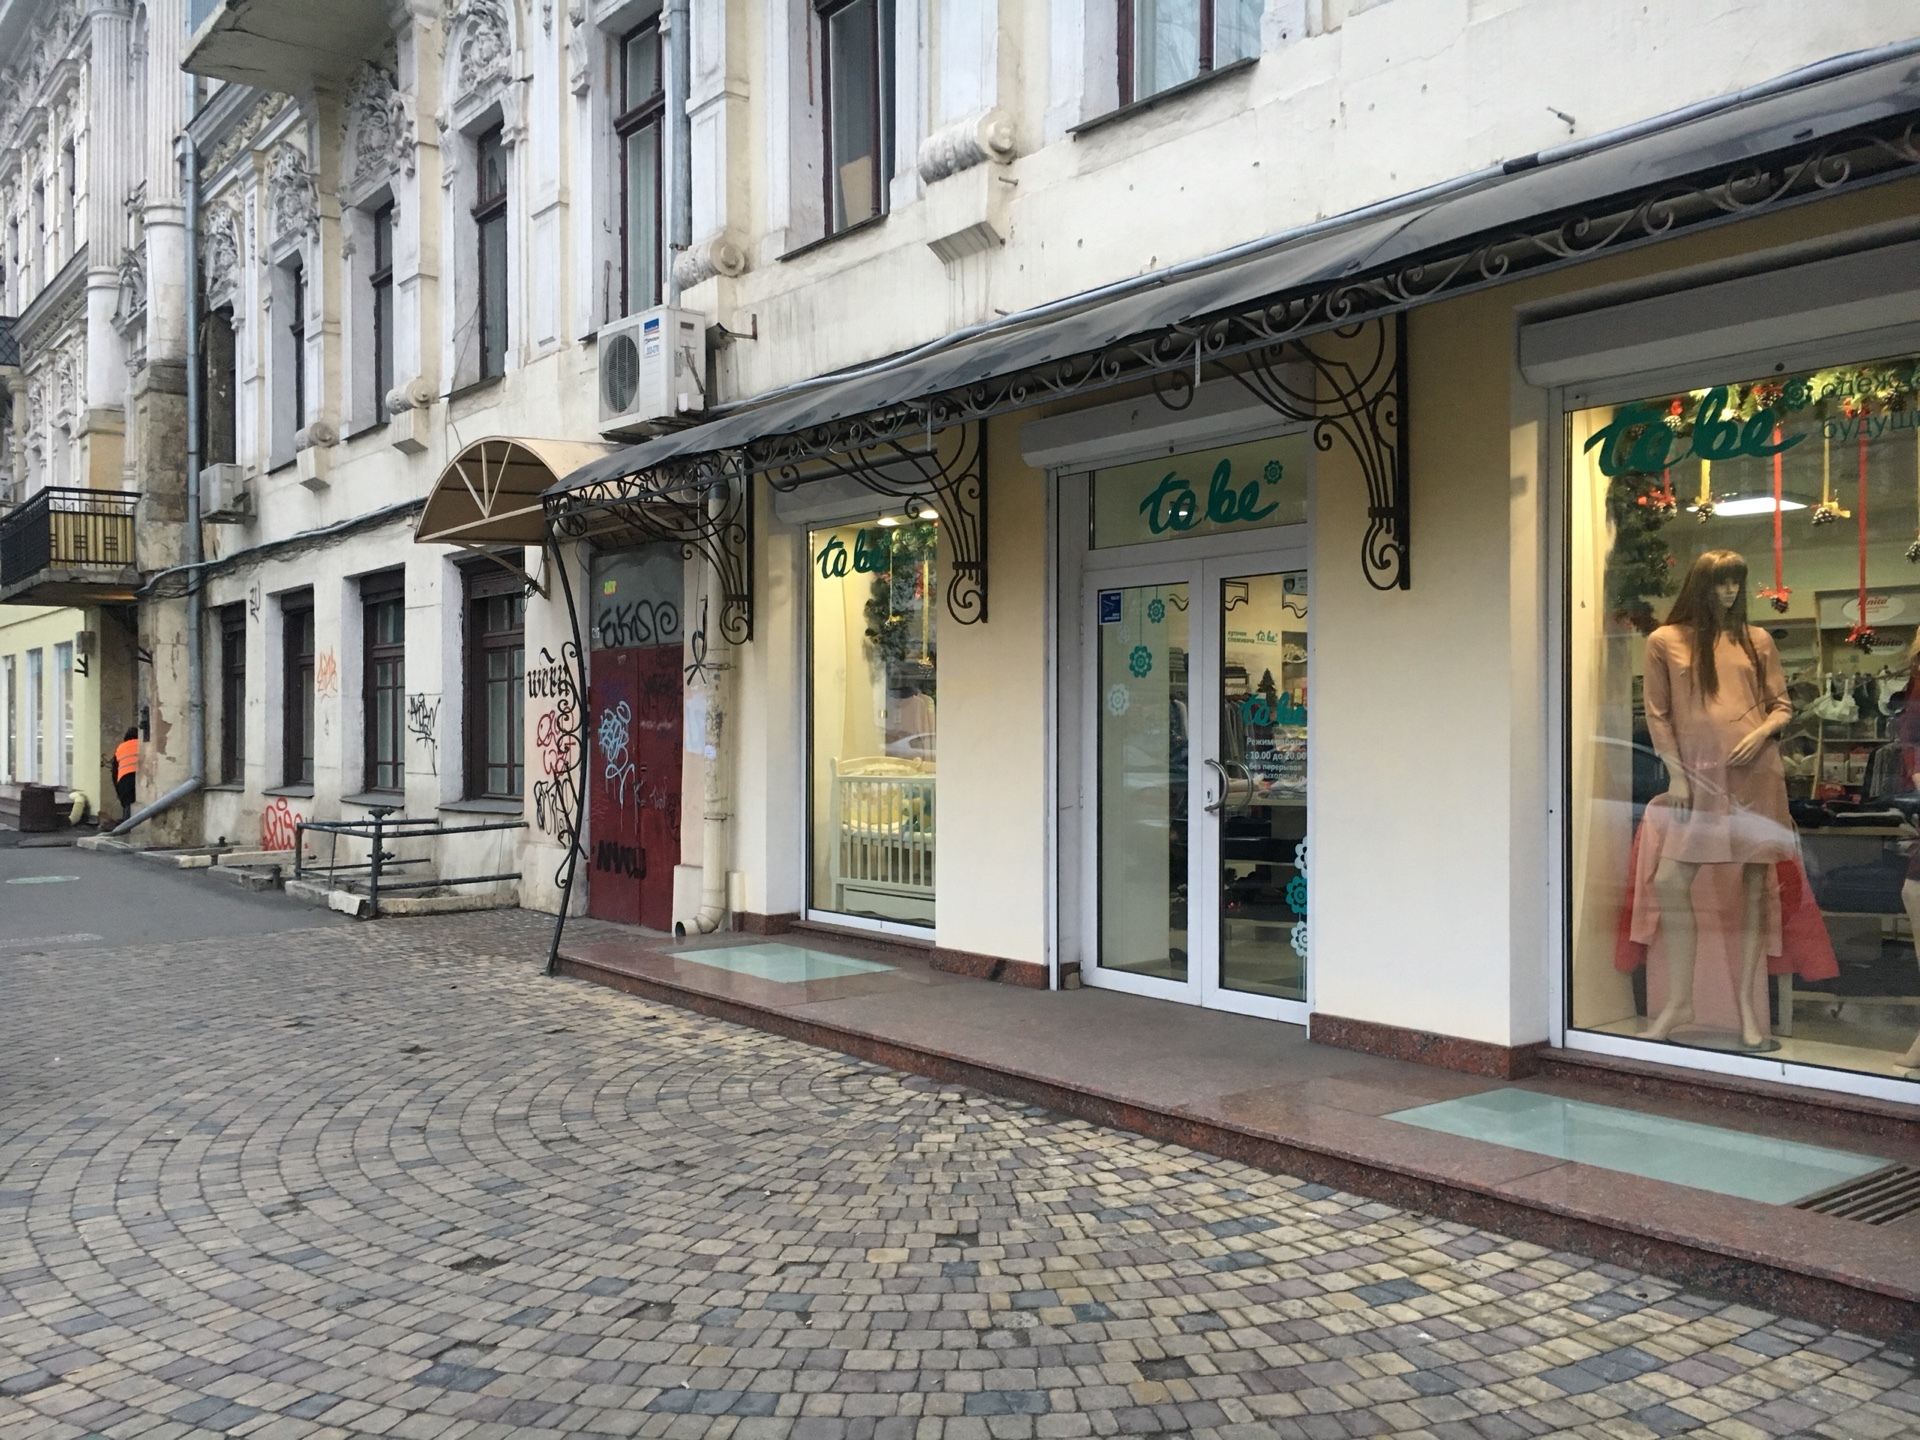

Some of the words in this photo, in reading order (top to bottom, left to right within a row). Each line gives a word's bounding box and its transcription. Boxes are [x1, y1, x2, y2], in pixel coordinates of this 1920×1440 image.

[1584, 402, 1684, 477] to
[1685, 386, 1807, 461] be
[1821, 410, 1920, 442] будущ
[1139, 471, 1203, 535] to
[1204, 458, 1280, 523] be
[816, 535, 853, 579] to
[852, 528, 892, 573] be
[1238, 692, 1273, 726] to
[1246, 737, 1273, 746] Режим
[1250, 750, 1271, 760] 10.00
[1272, 753, 1283, 761] до
[1284, 751, 1306, 761] 20.00
